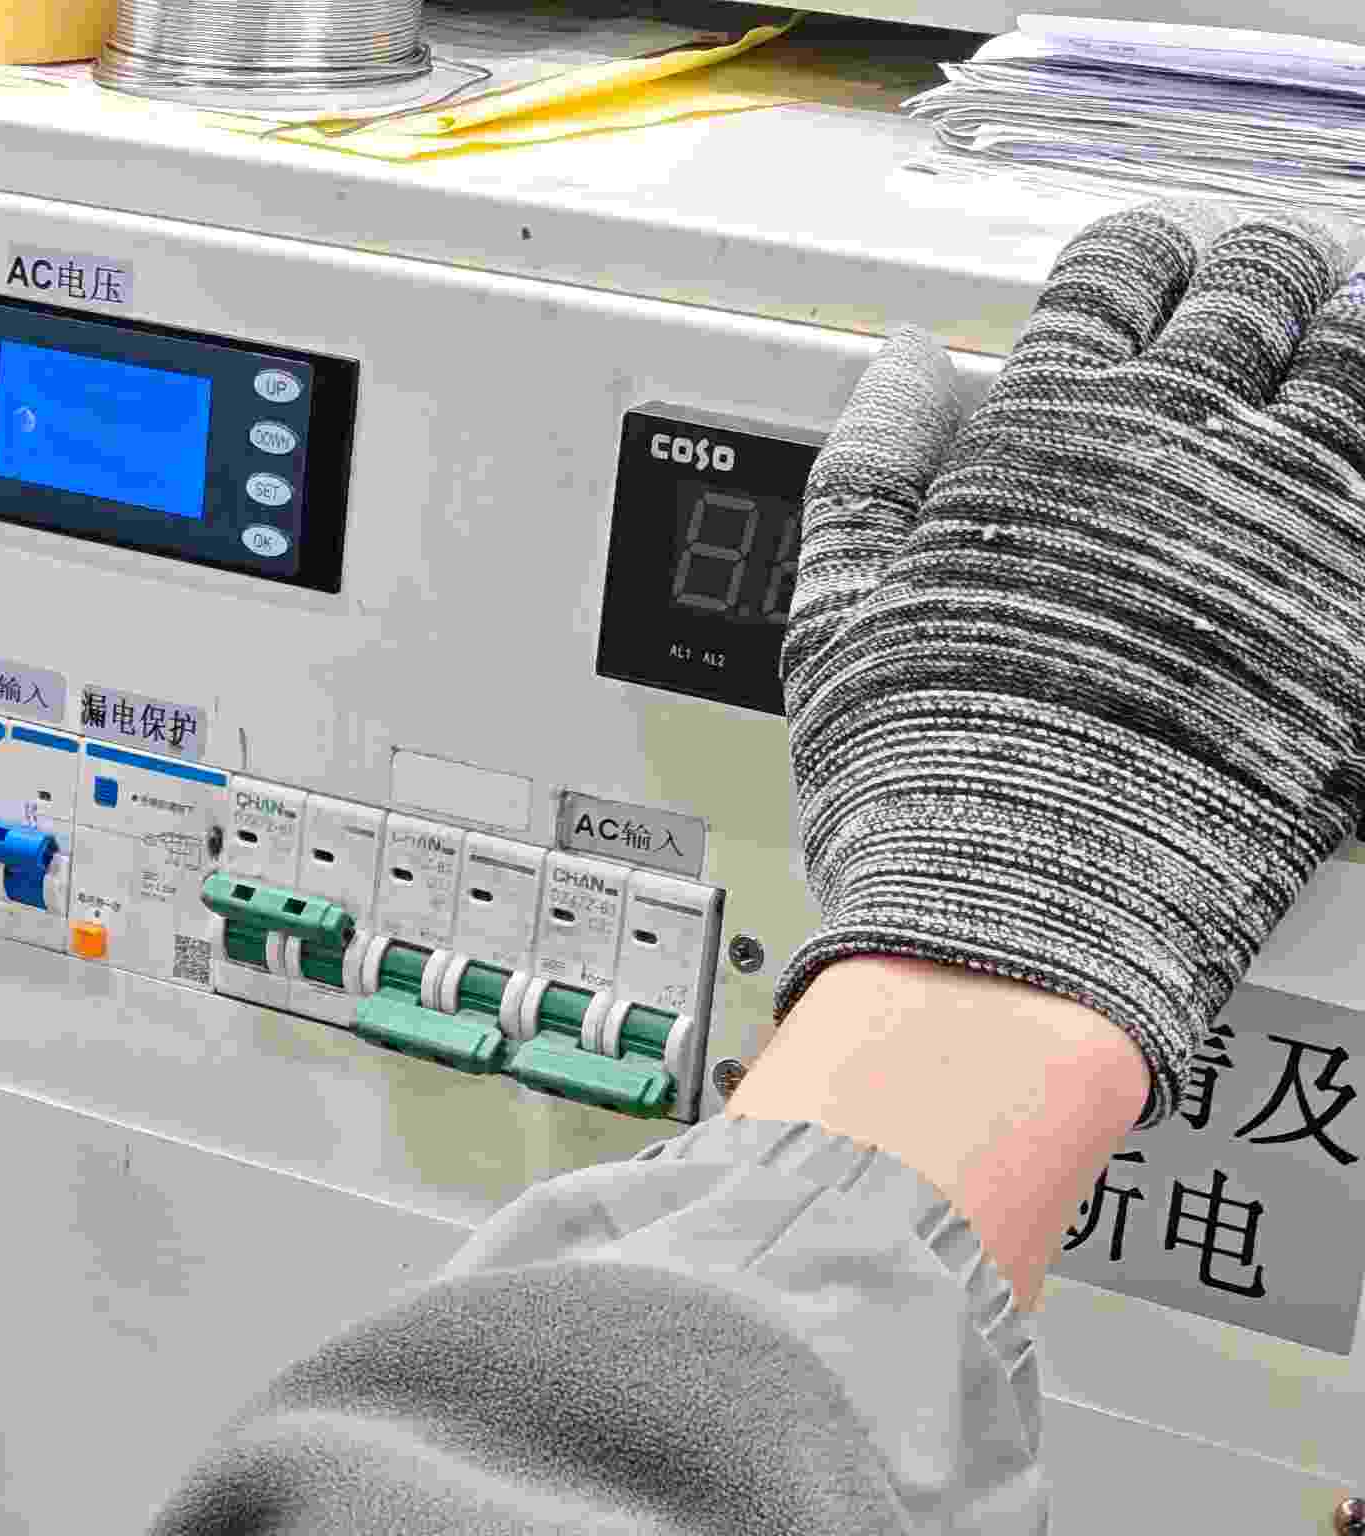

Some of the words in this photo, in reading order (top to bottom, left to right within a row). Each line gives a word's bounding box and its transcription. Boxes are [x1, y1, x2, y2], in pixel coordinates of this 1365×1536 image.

[7, 256, 125, 303] AC电压
[265, 381, 288, 397] UP
[255, 427, 295, 450] DOWN
[255, 481, 282, 502] SET
[252, 534, 278, 549] OK
[670, 643, 693, 662] AL1
[703, 651, 726, 668] AL2
[80, 690, 197, 747] 漏电保护
[574, 813, 684, 857] AC输入
